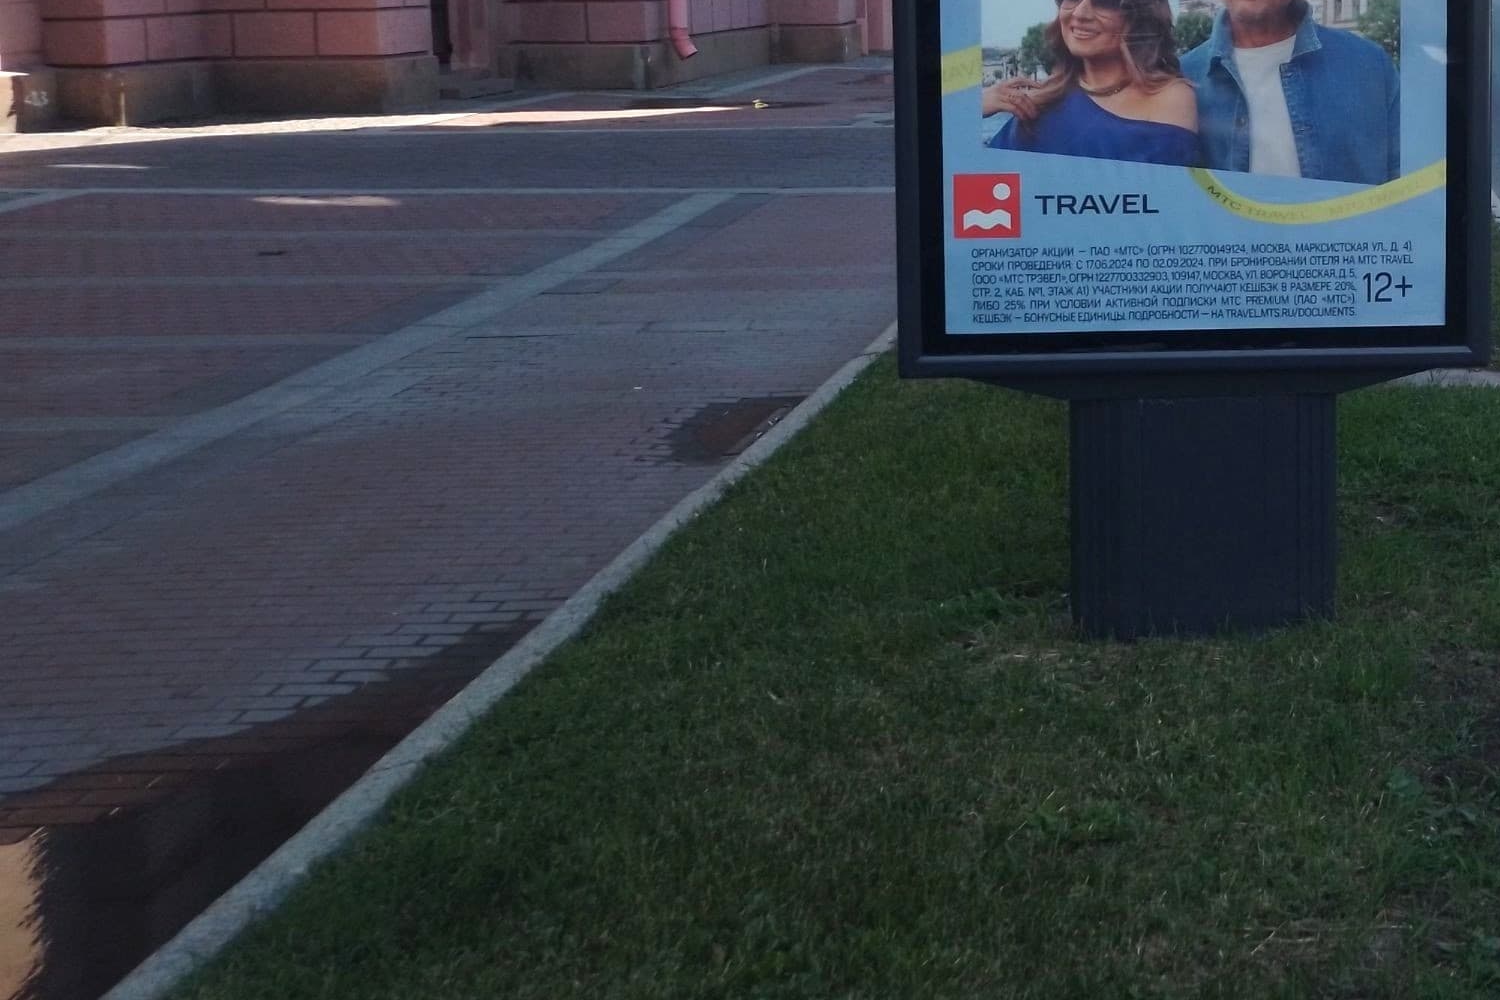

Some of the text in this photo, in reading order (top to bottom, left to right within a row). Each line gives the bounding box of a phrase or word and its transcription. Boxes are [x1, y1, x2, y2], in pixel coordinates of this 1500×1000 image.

[1034, 193, 1160, 215] TRAVEL
[971, 247, 1039, 258] ОРГАНИЗАТОР
[1042, 247, 1074, 258] АКЦИИ
[1090, 246, 1110, 256] ПАО
[1147, 244, 1175, 256] (ОГРН
[1295, 242, 1368, 253] МАРКСИСТСКАЯ
[971, 261, 1004, 271] СРОКИ
[1076, 259, 1083, 270] С
[1136, 258, 1150, 269] ПО
[1209, 257, 1228, 267] ПРИ
[1231, 256, 1307, 267] БРОНИРОВАНИИ
[1310, 255, 1340, 265] ОТЕЛЯ
[1343, 255, 1355, 264] НА
[1359, 254, 1378, 264] МТС
[1381, 254, 1414, 264] TRAVEL
[972, 273, 997, 285] (ООО
[1069, 272, 1094, 282] ОГРН
[1048, 286, 1073, 296] ЭТАЖ
[1092, 285, 1148, 295] УЧАСТНИКИ
[1151, 283, 1182, 294] АКЦИИ
[1185, 282, 1238, 293] ПОЛУЧАЮТ
[1240, 282, 1278, 292] КЕШБЭК
[1281, 281, 1288, 292] В
[1290, 281, 1332, 292] РАЗМЕРЕ
[1362, 271, 1413, 304] 12+
[973, 300, 1000, 311] ЛИБО
[1004, 300, 1026, 310] 25%
[1030, 299, 1050, 310] ПРИ
[1055, 298, 1101, 309] УСЛОВИИ
[1105, 296, 1158, 308] АКТИВНОЙ
[1162, 296, 1217, 307] ПОДПИСКИ
[1221, 296, 1241, 306] МТС
[1246, 295, 1289, 305] PREMIUM
[1294, 294, 1318, 306] (ПАО
[973, 313, 1012, 324] КЕШБЭК
[1024, 312, 1076, 323] БОНУСНЫЕ
[1128, 309, 1200, 321] ПОДРОБНОСТИ
[1211, 309, 1224, 319] НА
